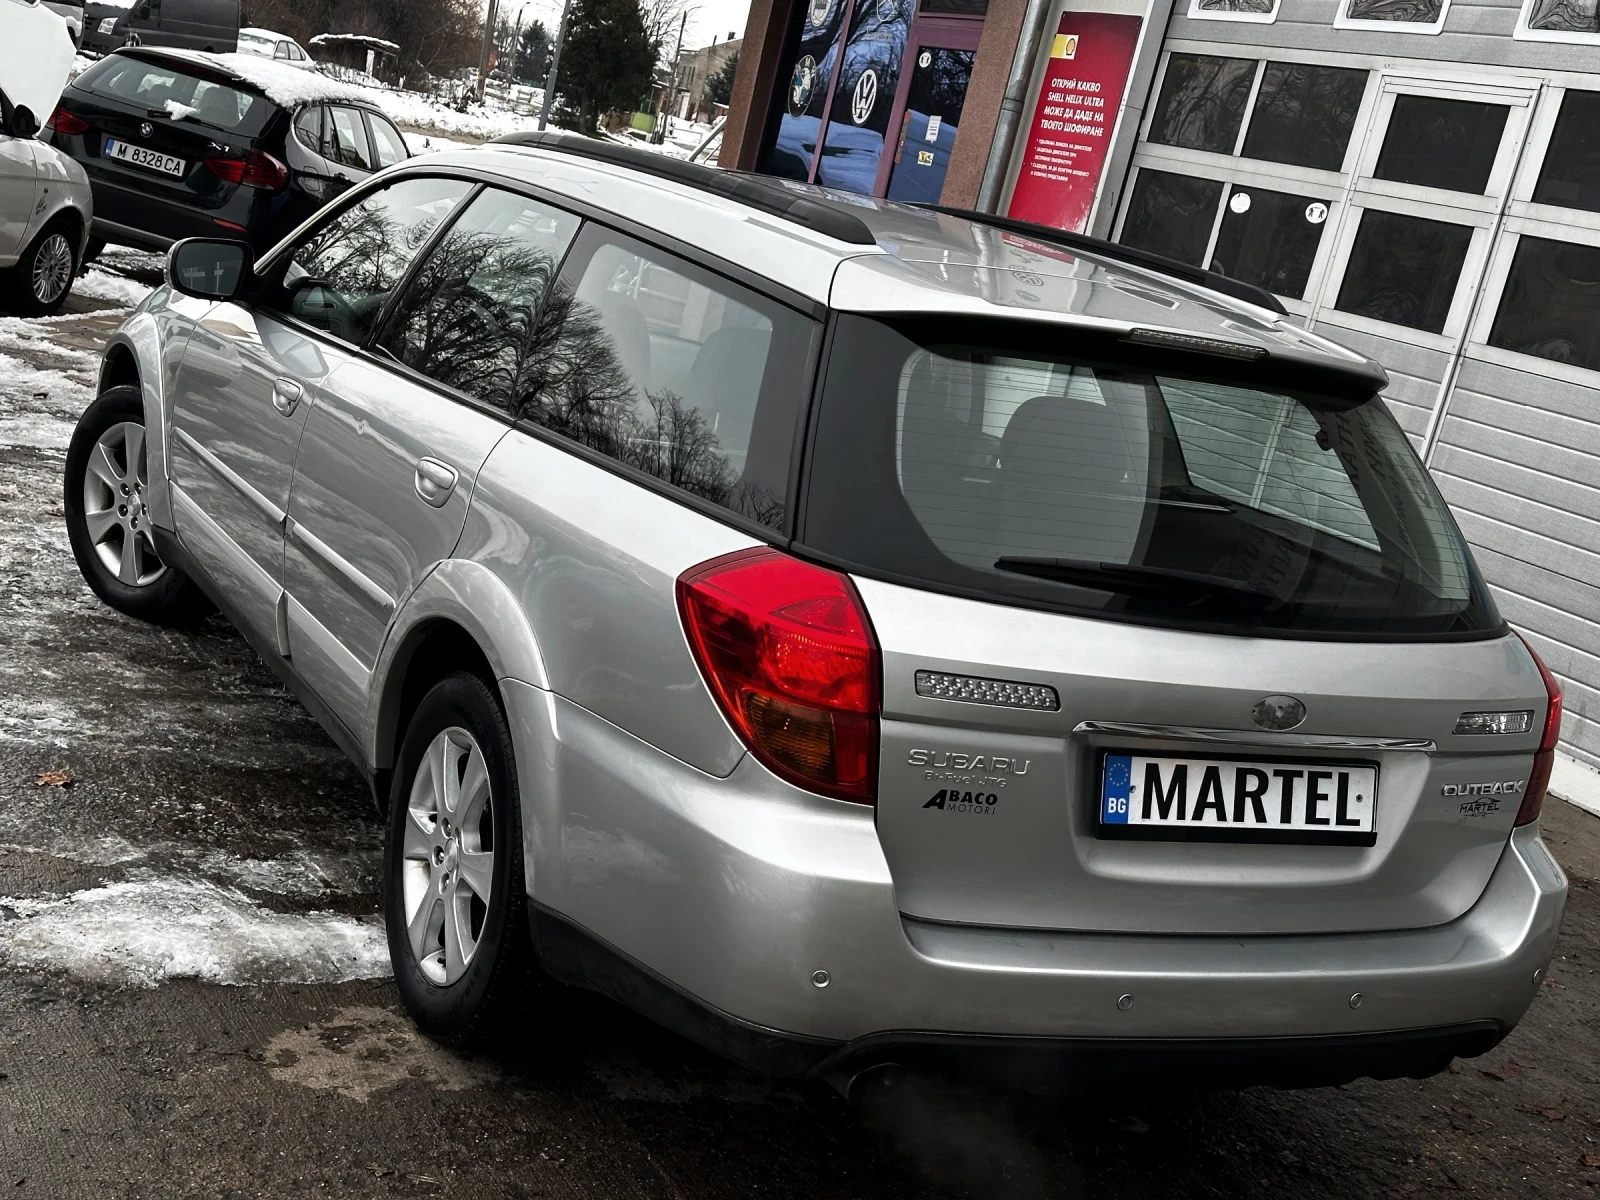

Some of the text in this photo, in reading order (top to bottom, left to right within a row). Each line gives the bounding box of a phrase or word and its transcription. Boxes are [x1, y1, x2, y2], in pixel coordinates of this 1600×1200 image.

[1051, 78, 1101, 92] ОТКРИЙ КАКВО
[1047, 92, 1104, 107] SHELL HELIX ULTRA
[1044, 106, 1104, 122] МОЖЕ ДА ДАДЕ НА
[1041, 119, 1104, 136] ТВОЕТО ШОФИРАНЕ
[117, 144, 128, 158] M
[131, 148, 163, 168] 8328
[164, 157, 180, 174] CA
[907, 749, 1031, 776] SUBARU
[1141, 762, 1362, 827] MARTEL
[1442, 780, 1524, 797] OUTBACK
[922, 789, 998, 811] ABACO
[1107, 798, 1127, 814] BG
[1459, 801, 1500, 814] MARTEL
[947, 803, 996, 815] MOTORI
